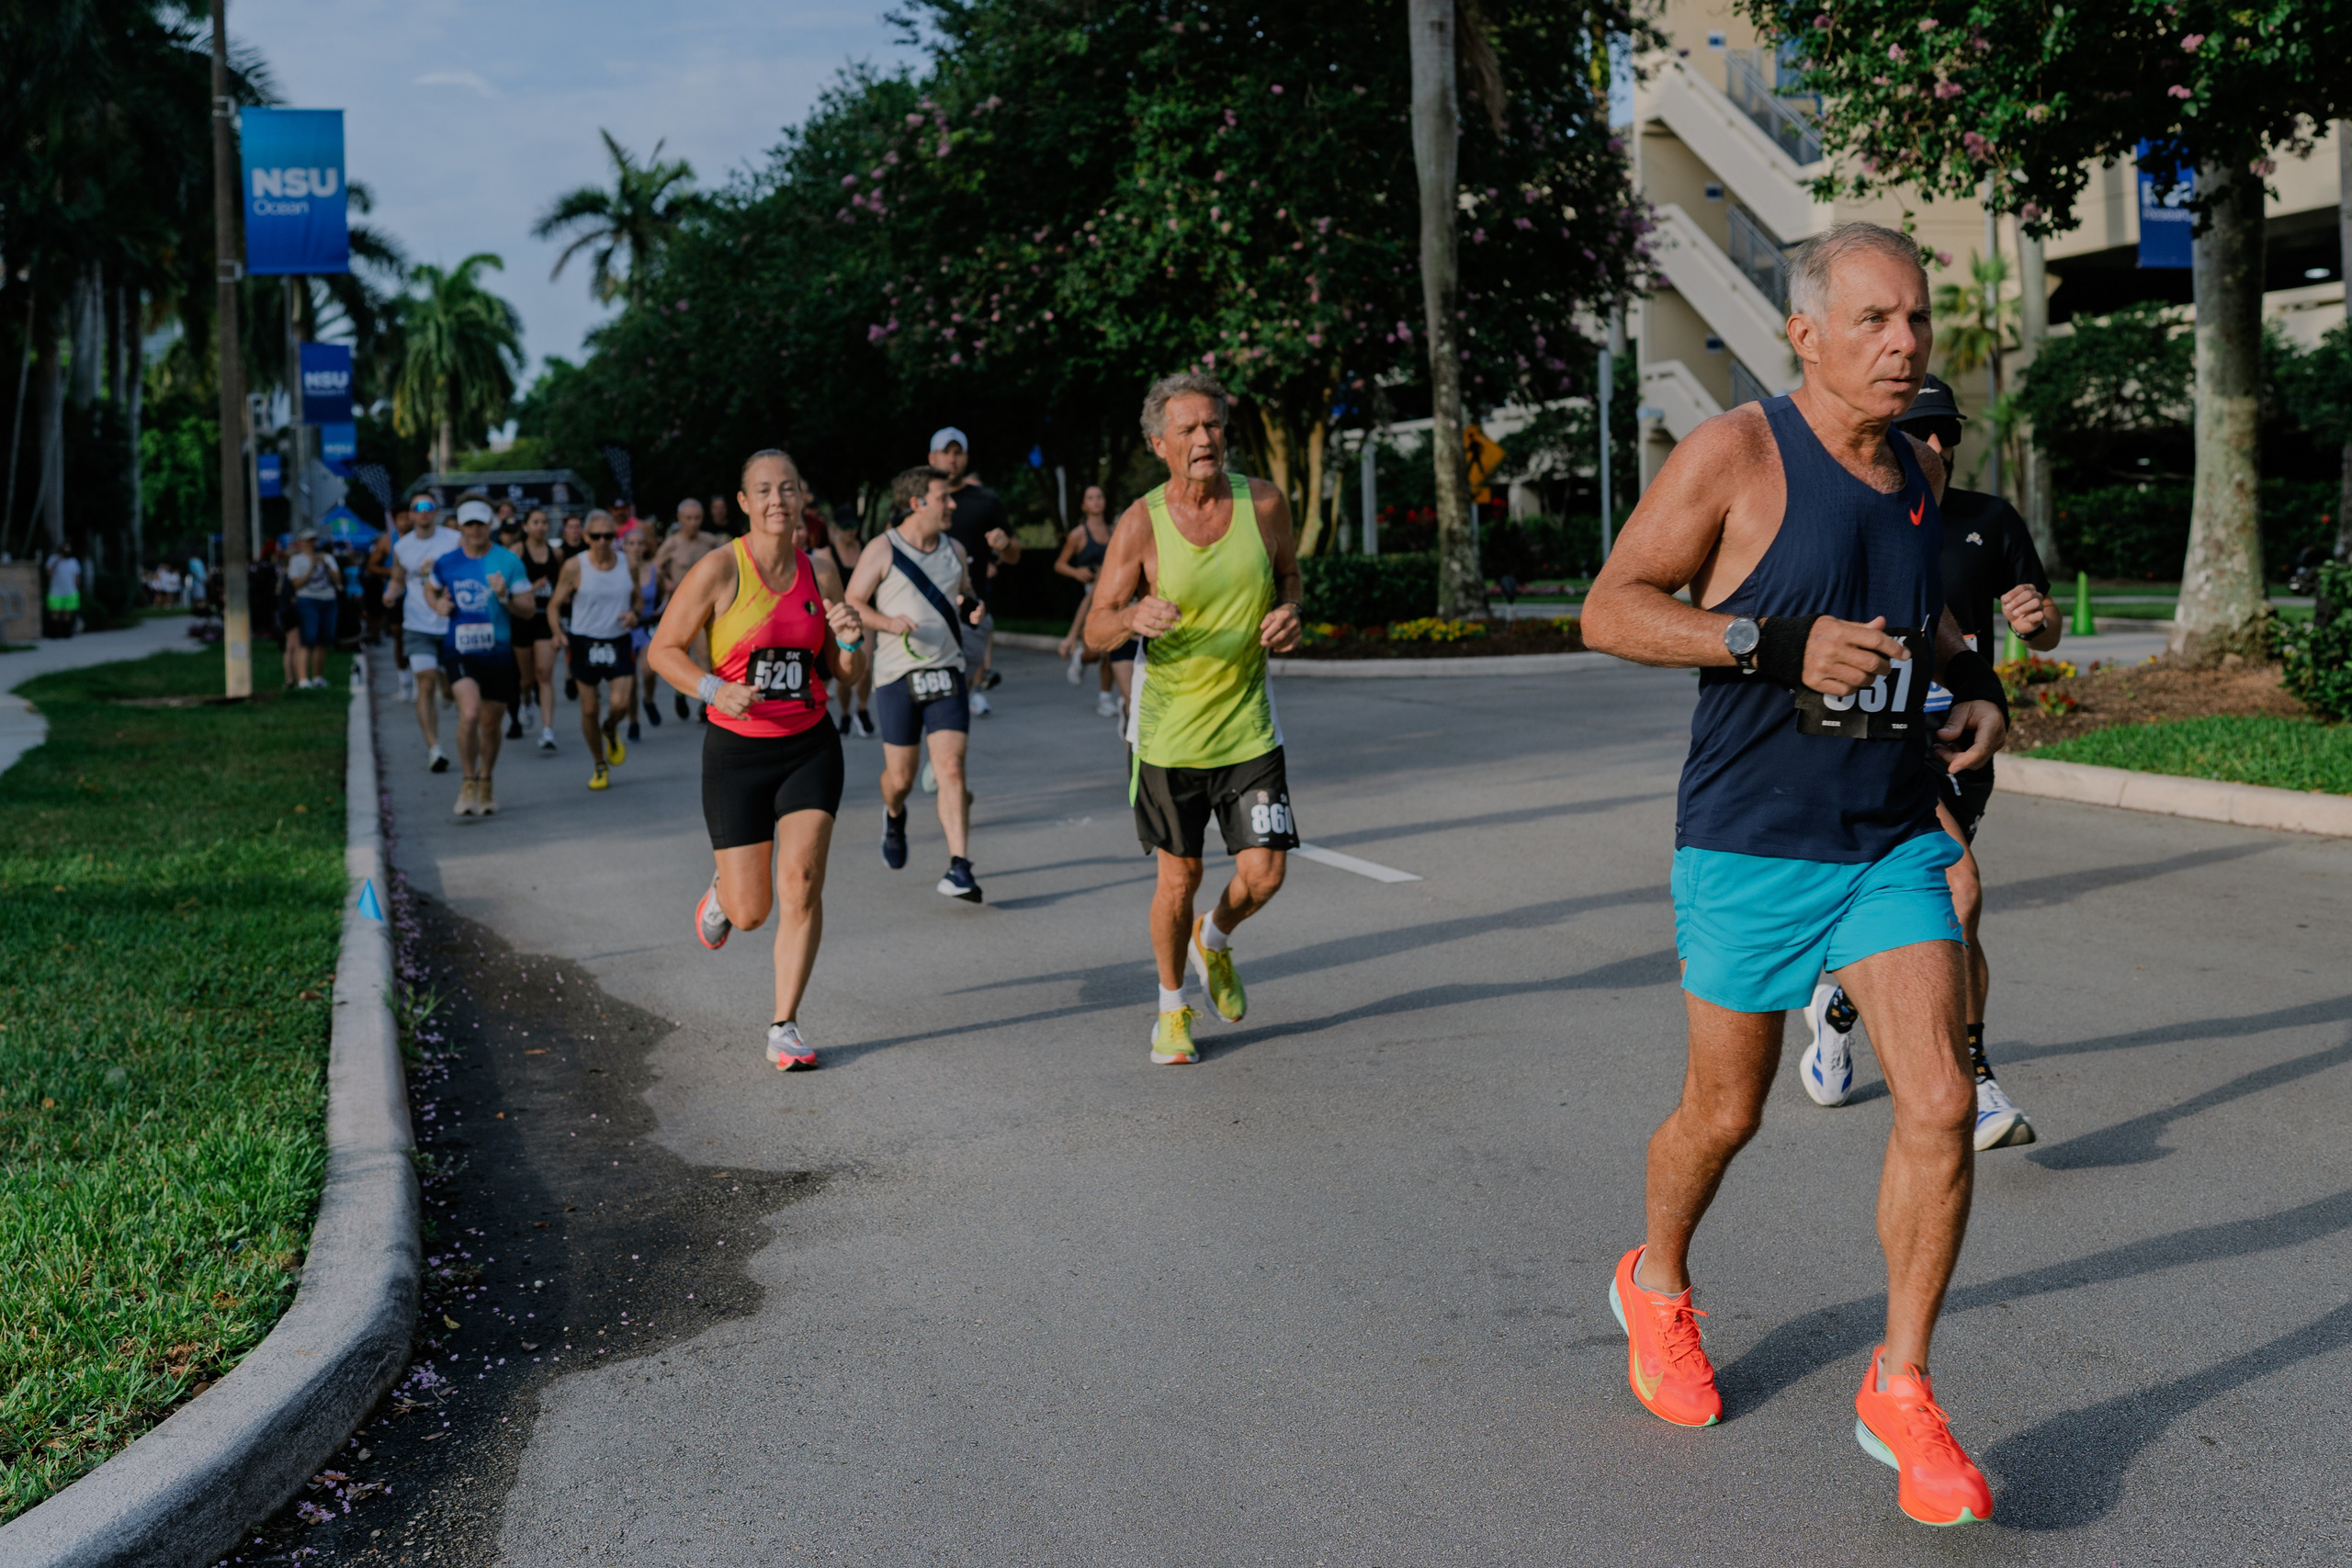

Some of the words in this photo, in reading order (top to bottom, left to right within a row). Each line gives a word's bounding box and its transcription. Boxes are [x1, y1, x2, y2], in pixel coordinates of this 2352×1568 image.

[252, 167, 338, 197] NSU
[254, 198, 311, 216] Ocean
[304, 371, 349, 389] NSU
[786, 650, 801, 660] 5K
[754, 660, 803, 690] 520
[912, 670, 953, 695] 568
[1823, 658, 1913, 712] 37
